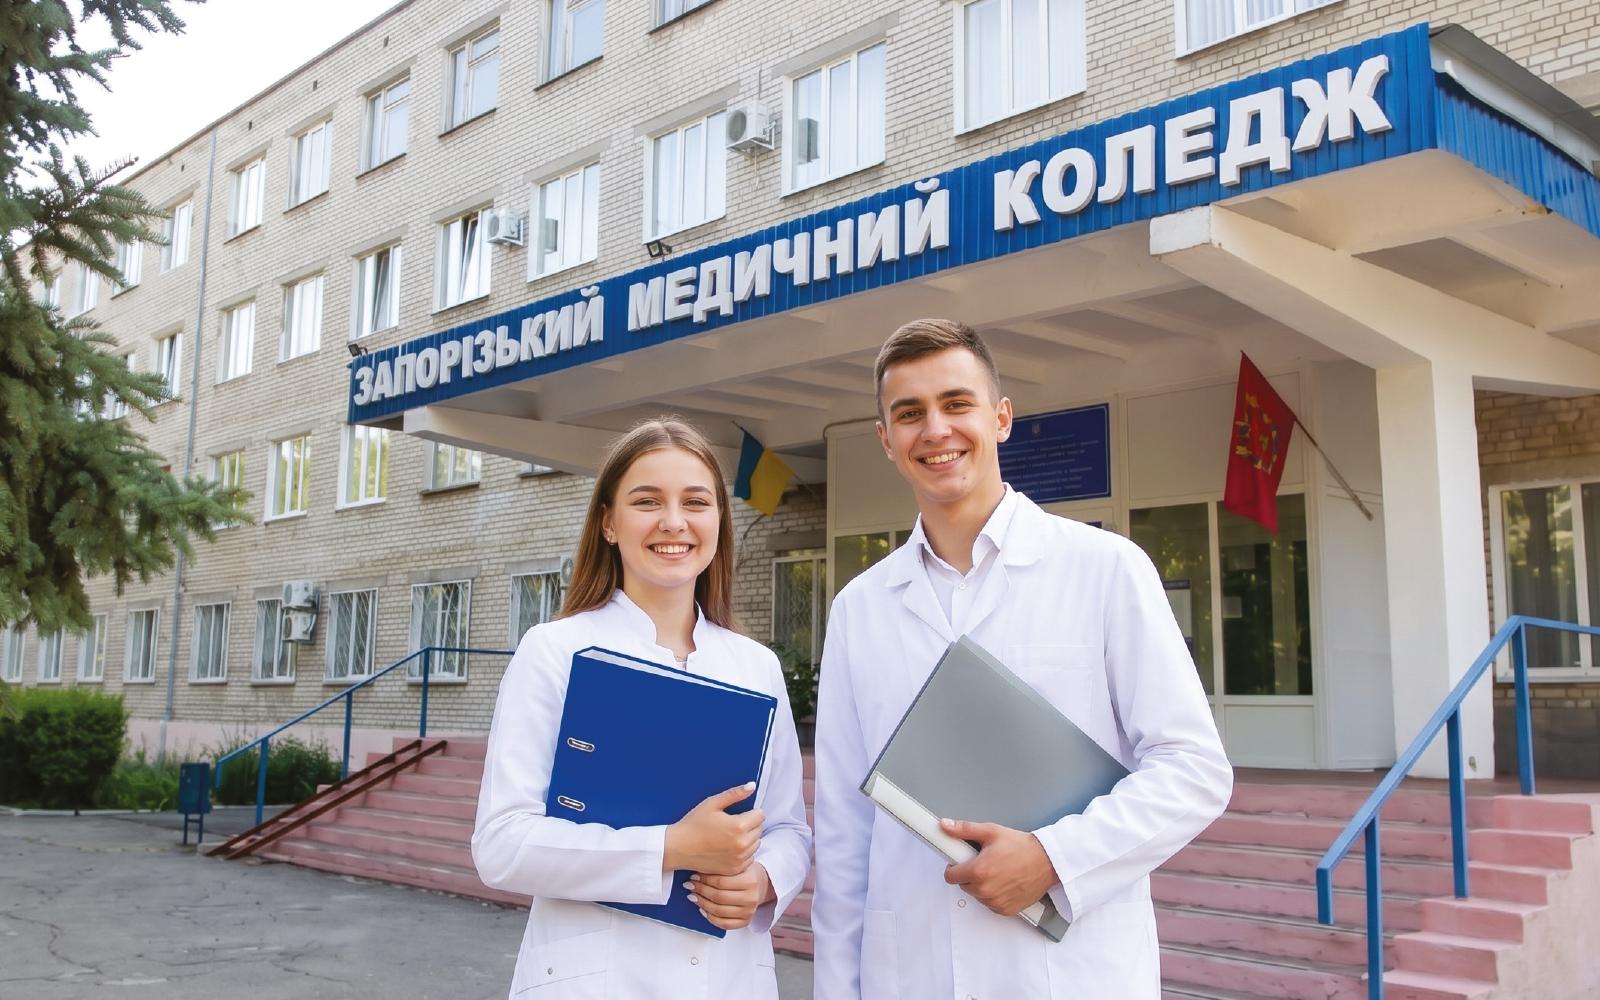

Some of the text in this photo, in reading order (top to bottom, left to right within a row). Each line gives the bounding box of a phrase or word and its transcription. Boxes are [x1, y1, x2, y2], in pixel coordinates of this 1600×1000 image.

[353, 54, 1393, 406] ЗАПОРІЗЬКИЙ МЕДИЧНИЙ КОЛЕДЖ
